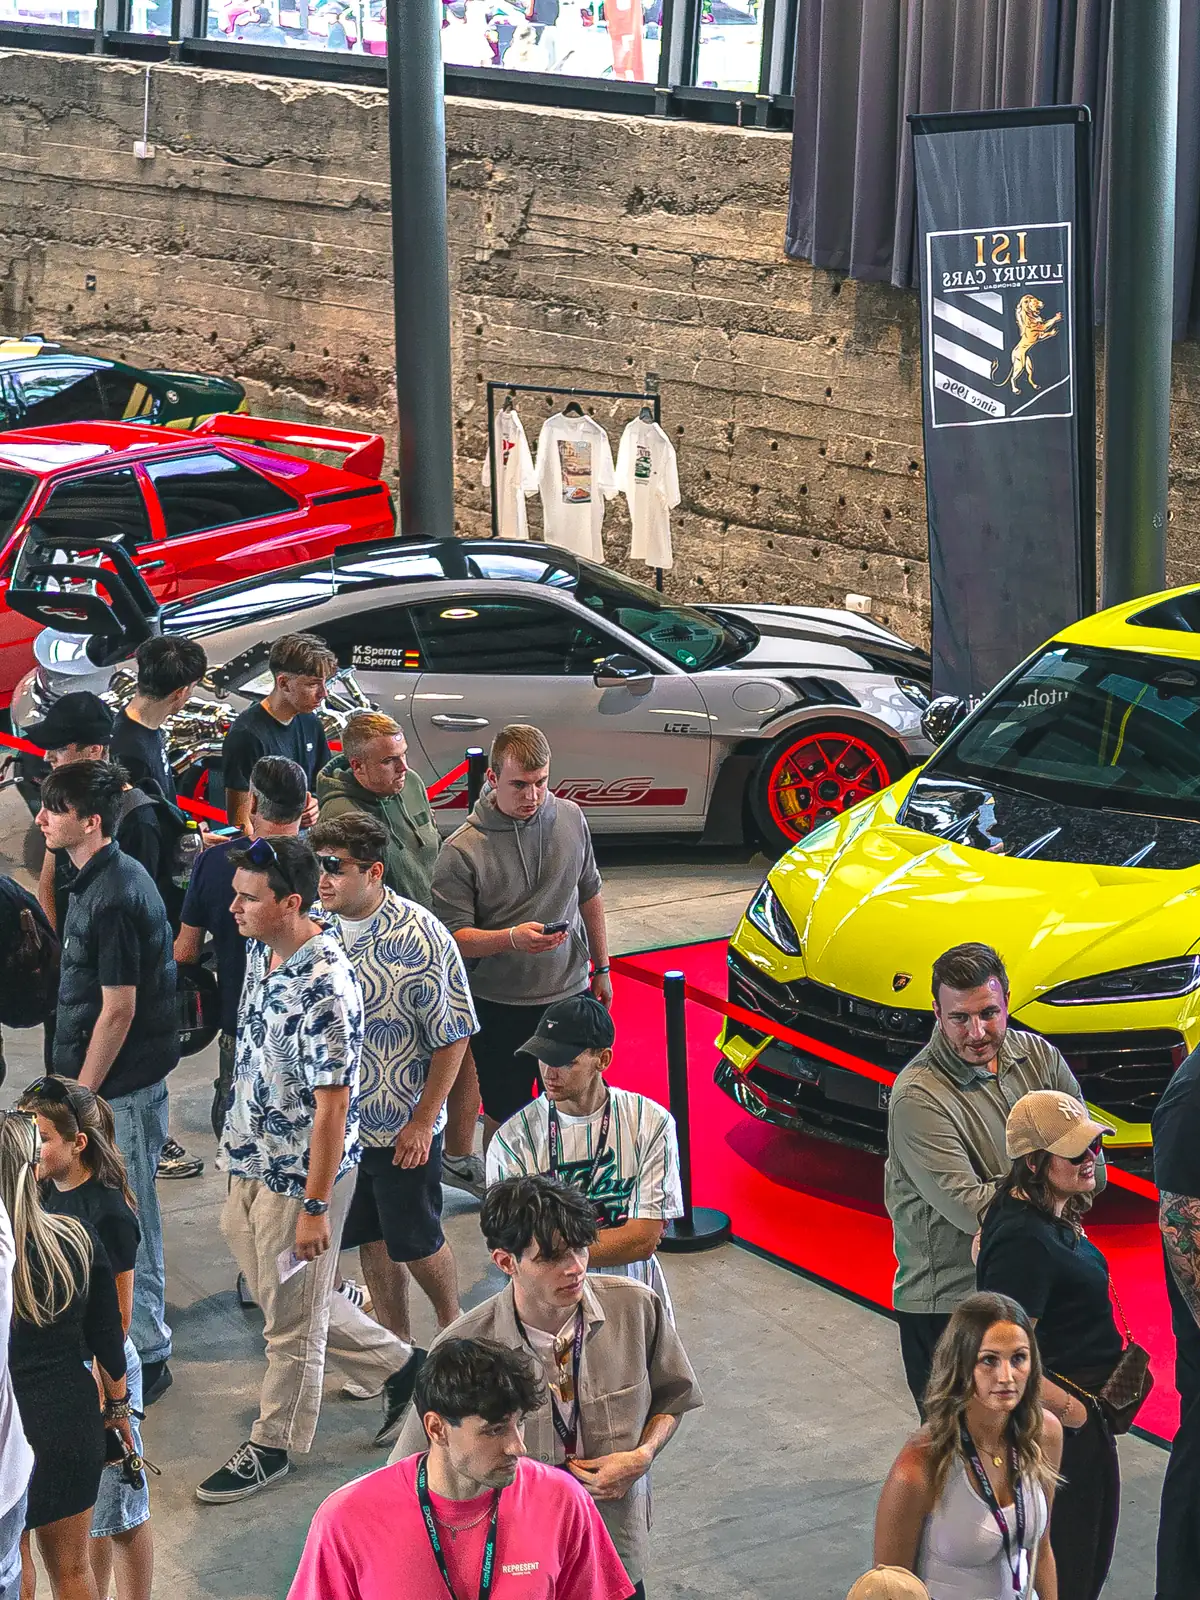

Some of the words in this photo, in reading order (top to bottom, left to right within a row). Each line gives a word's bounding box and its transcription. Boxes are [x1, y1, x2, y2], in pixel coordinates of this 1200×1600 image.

[353, 645, 403, 657] K.Sperrer
[352, 655, 402, 667] M.Sperrer
[502, 1561, 540, 1574] REPRESENT
